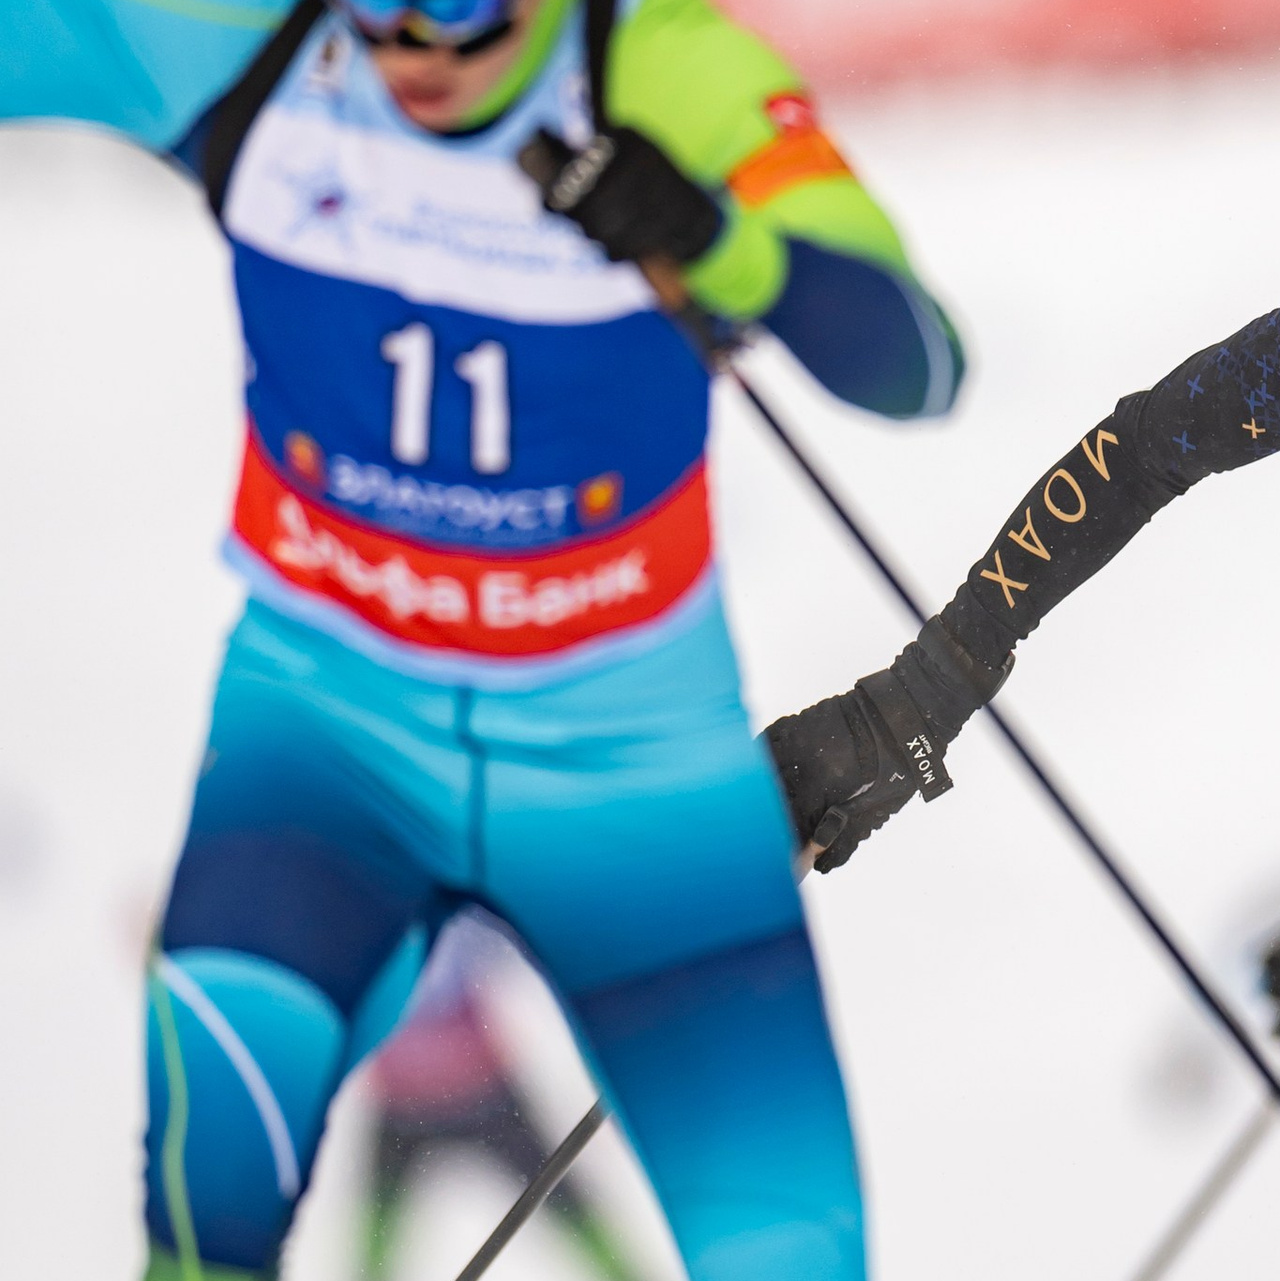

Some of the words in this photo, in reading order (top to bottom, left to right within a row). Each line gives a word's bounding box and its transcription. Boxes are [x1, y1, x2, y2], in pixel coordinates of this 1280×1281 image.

[380, 322, 511, 475] 11
[981, 429, 1119, 609] MOAX
[906, 737, 936, 785] MOAX
